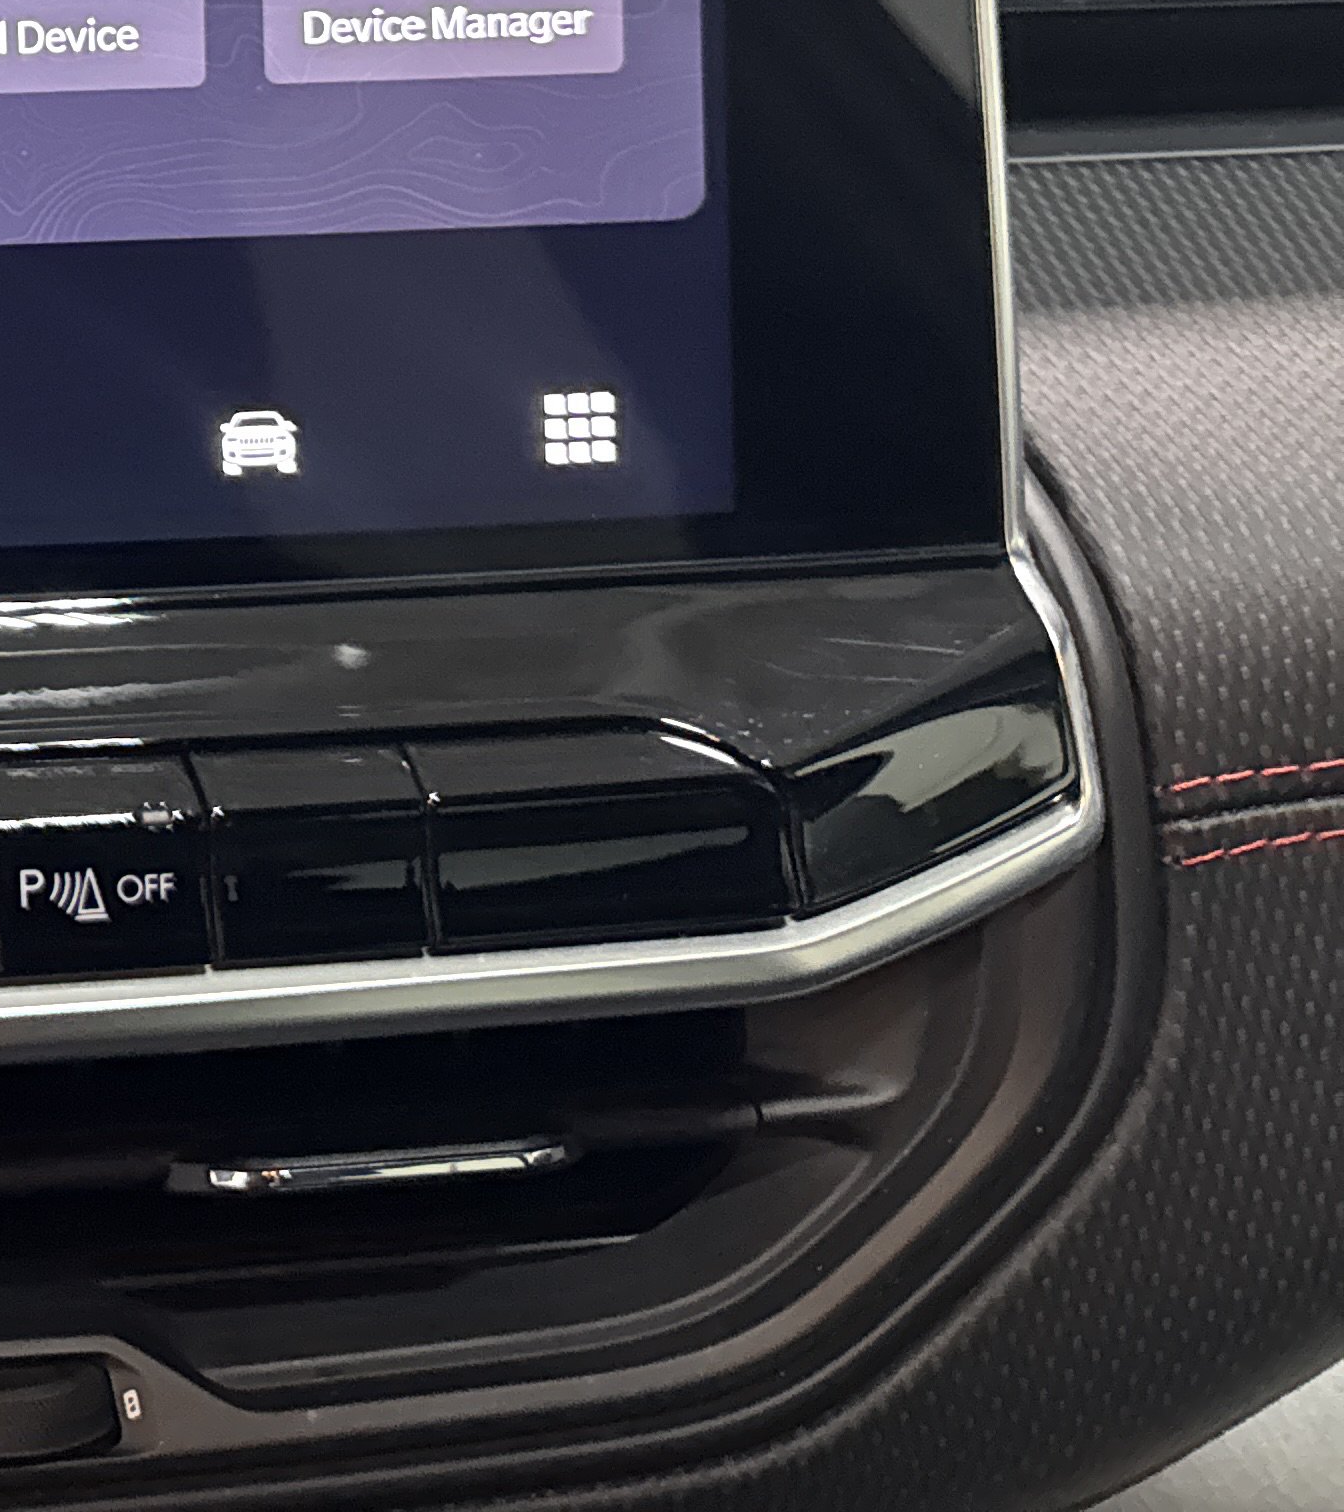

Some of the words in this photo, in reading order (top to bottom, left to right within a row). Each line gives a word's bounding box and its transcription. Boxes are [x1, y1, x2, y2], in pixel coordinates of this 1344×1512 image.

[16, 16, 141, 56] Device
[302, 6, 428, 46] Device
[430, 4, 595, 45] Manager
[18, 867, 46, 909] P
[115, 871, 175, 904] OFF
